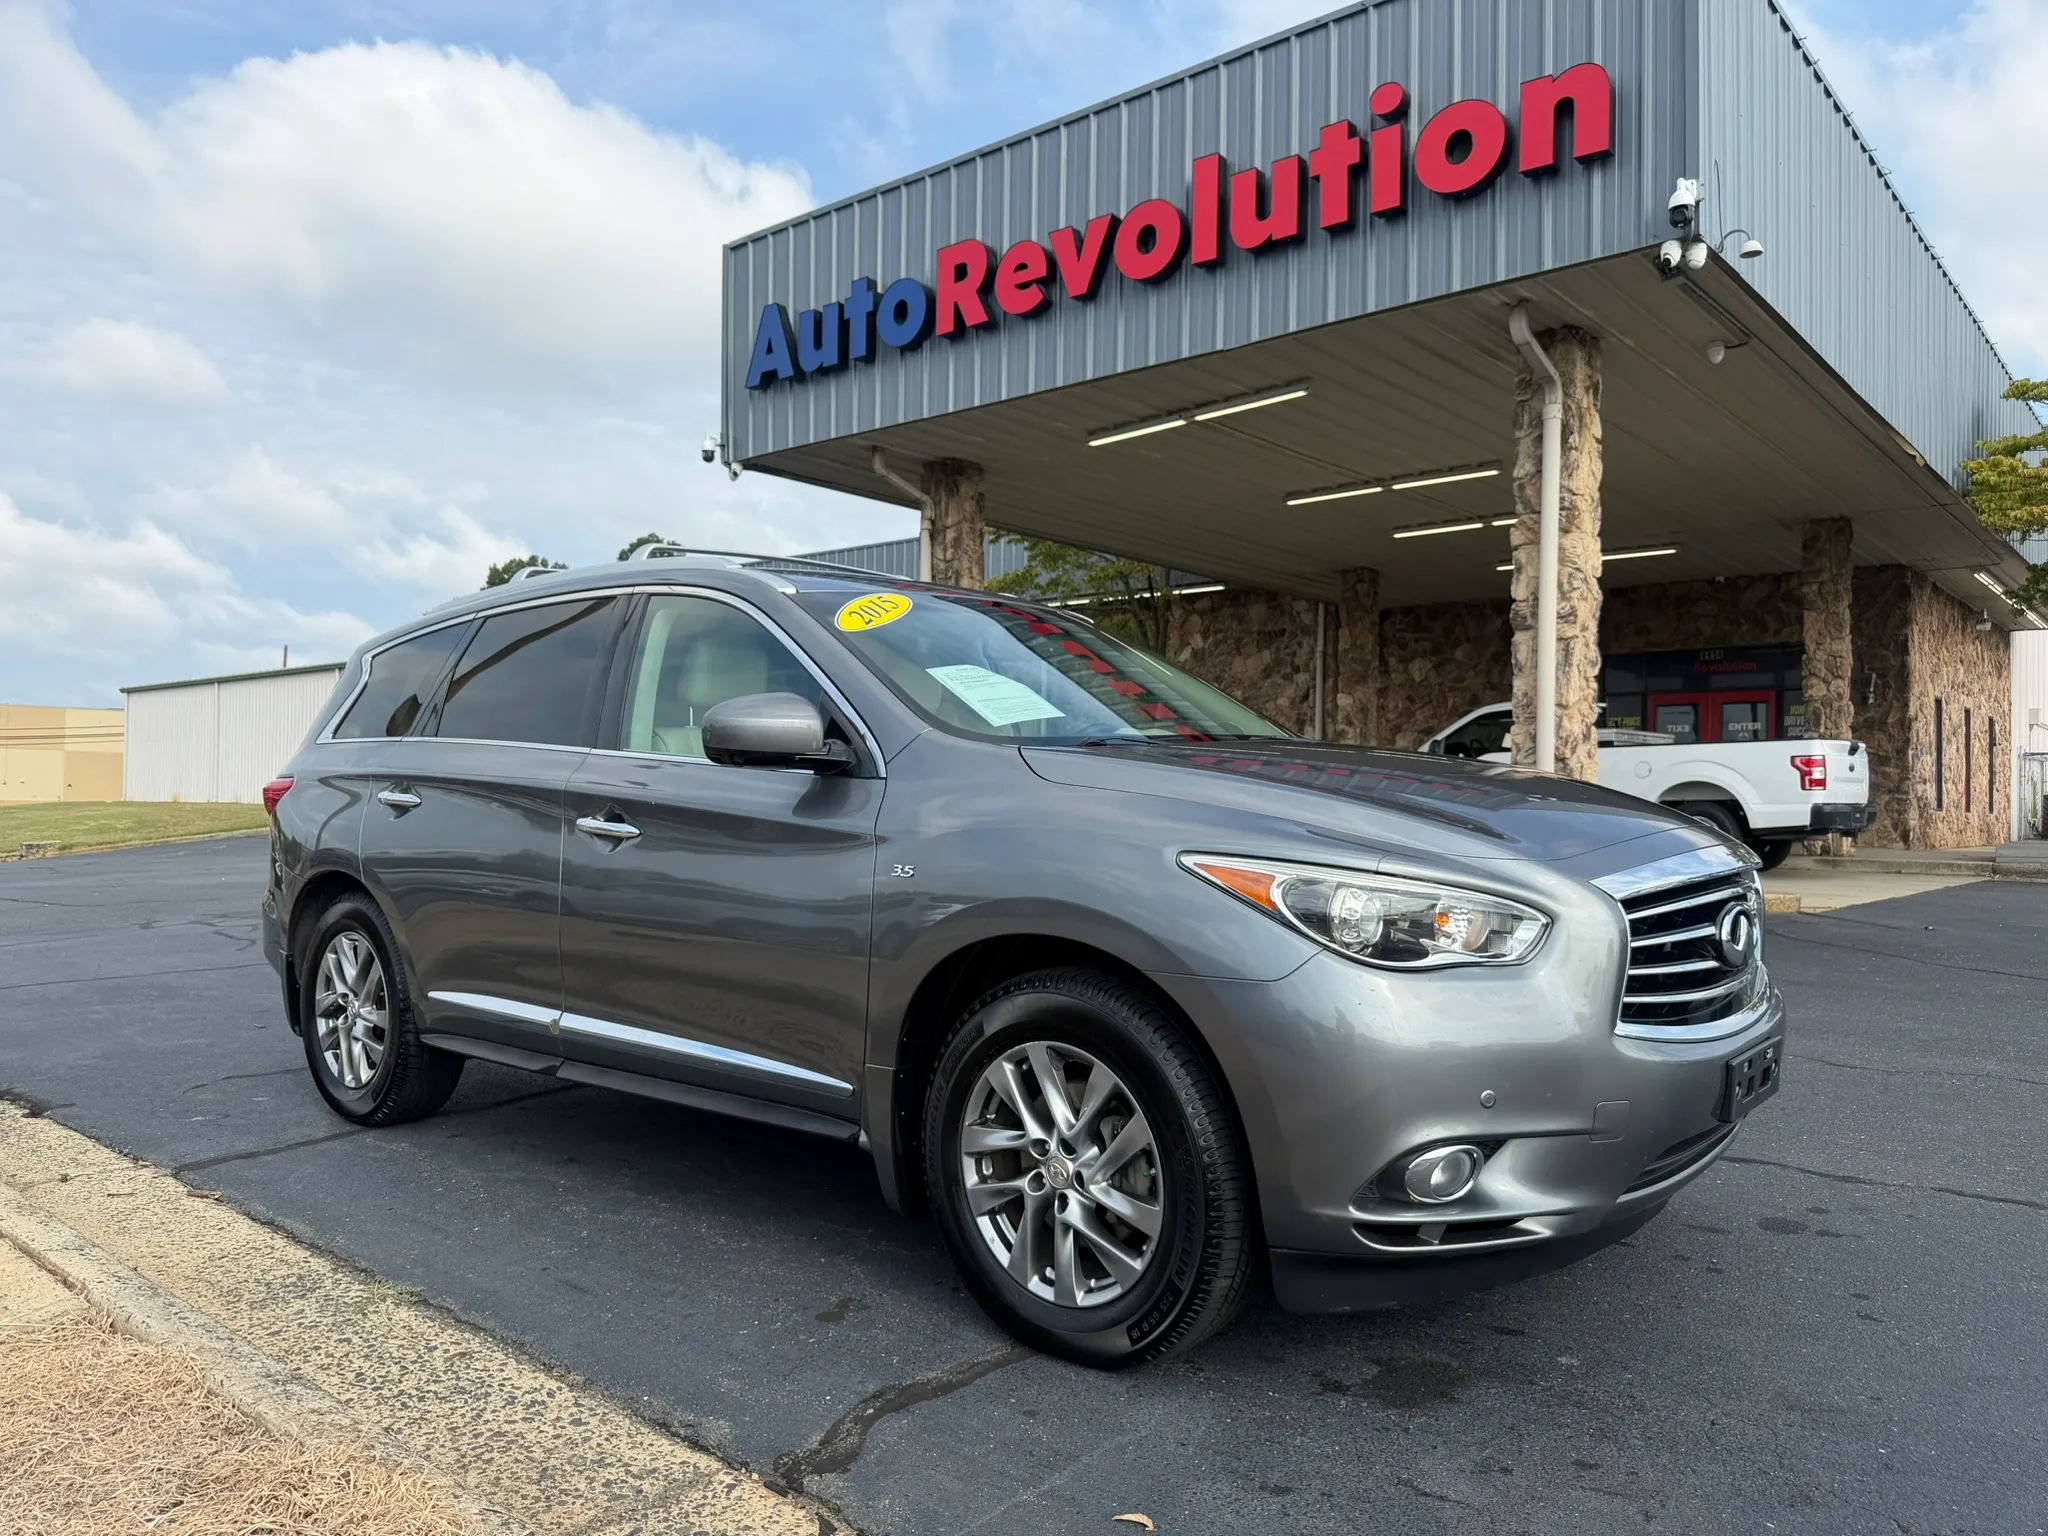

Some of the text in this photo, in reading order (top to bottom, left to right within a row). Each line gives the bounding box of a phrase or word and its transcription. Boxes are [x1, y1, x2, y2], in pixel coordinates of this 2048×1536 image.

[848, 596, 899, 625] 2015
[1727, 722, 1761, 731] ENTER
[1174, 1176, 1197, 1282] MICHELIN
